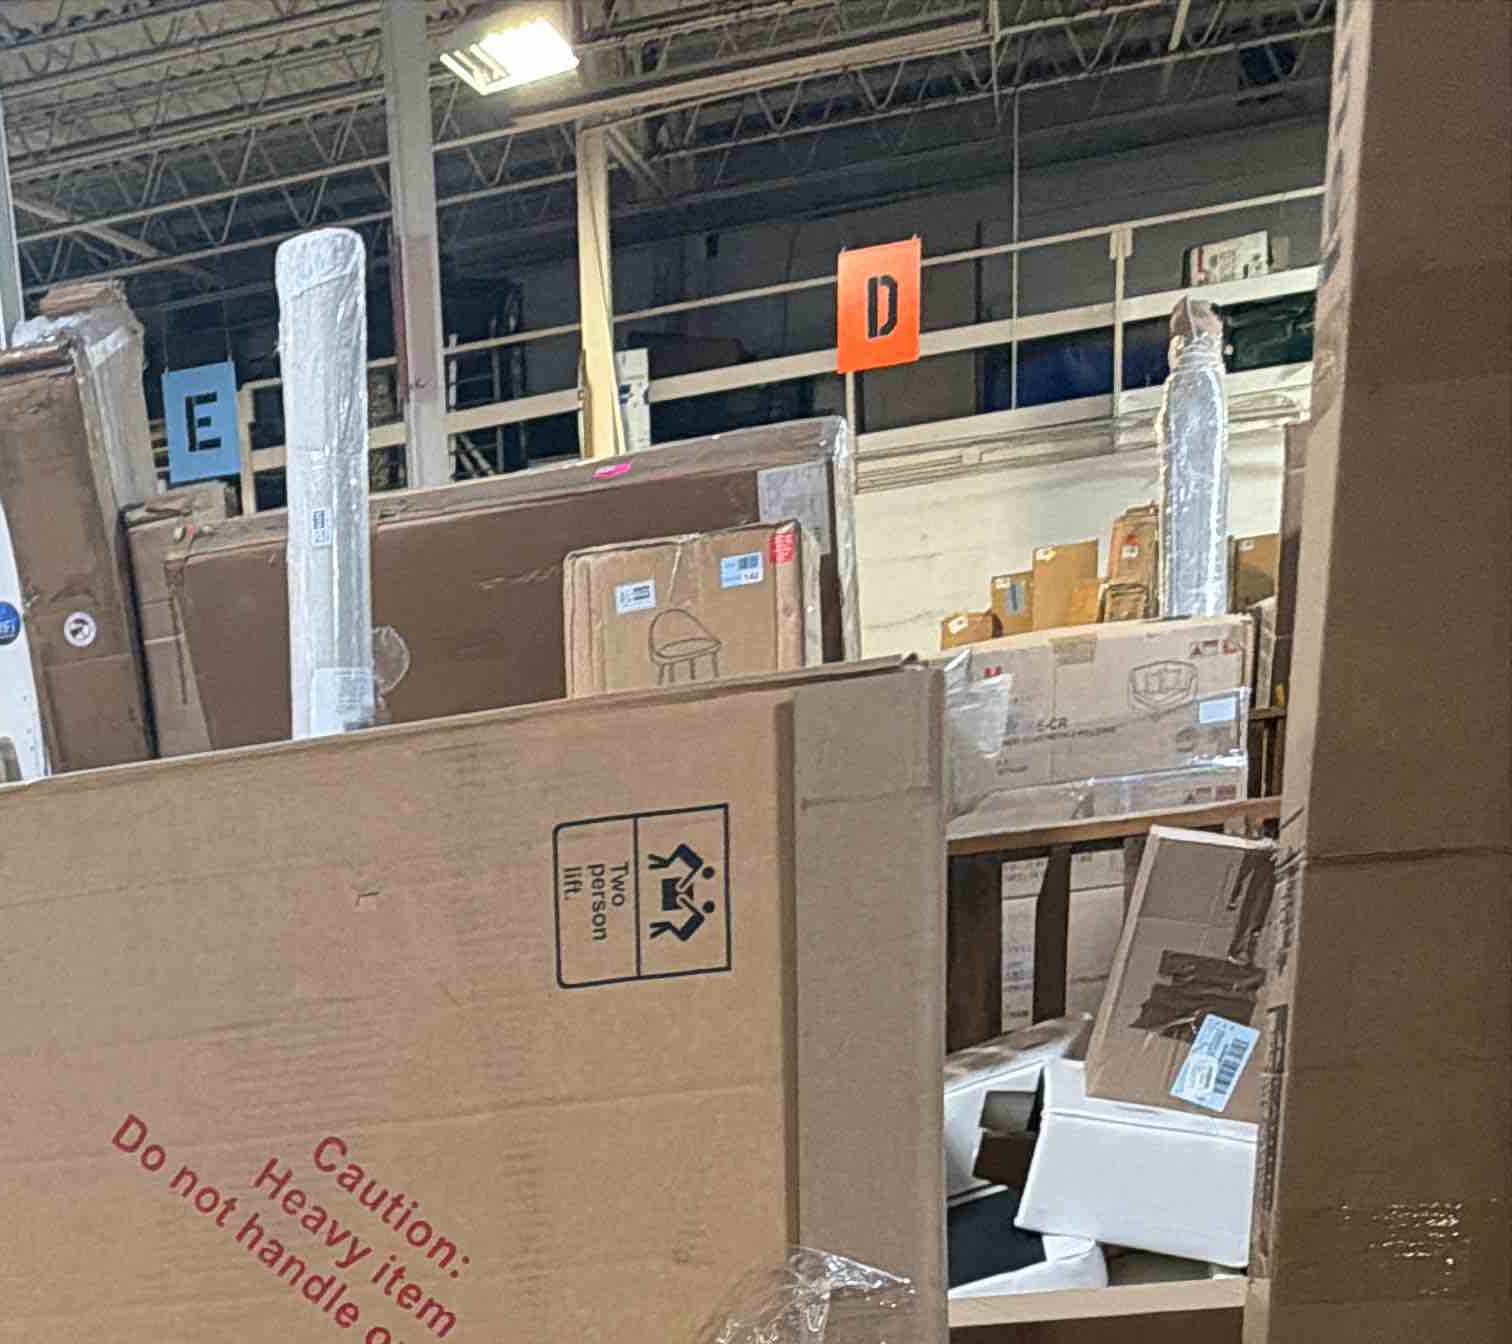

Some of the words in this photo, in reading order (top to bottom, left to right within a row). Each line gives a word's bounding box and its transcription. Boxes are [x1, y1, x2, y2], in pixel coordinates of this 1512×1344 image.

[866, 274, 899, 339] D
[185, 391, 221, 453] E
[563, 866, 584, 901] lift.
[587, 863, 608, 942] person
[611, 862, 629, 908] Two
[111, 1113, 168, 1172] Do
[169, 1165, 238, 1228] not
[236, 1212, 361, 1329] handle
[313, 1136, 470, 1279] Caution:
[253, 1156, 372, 1270] Heavy
[371, 1255, 458, 1339] item
